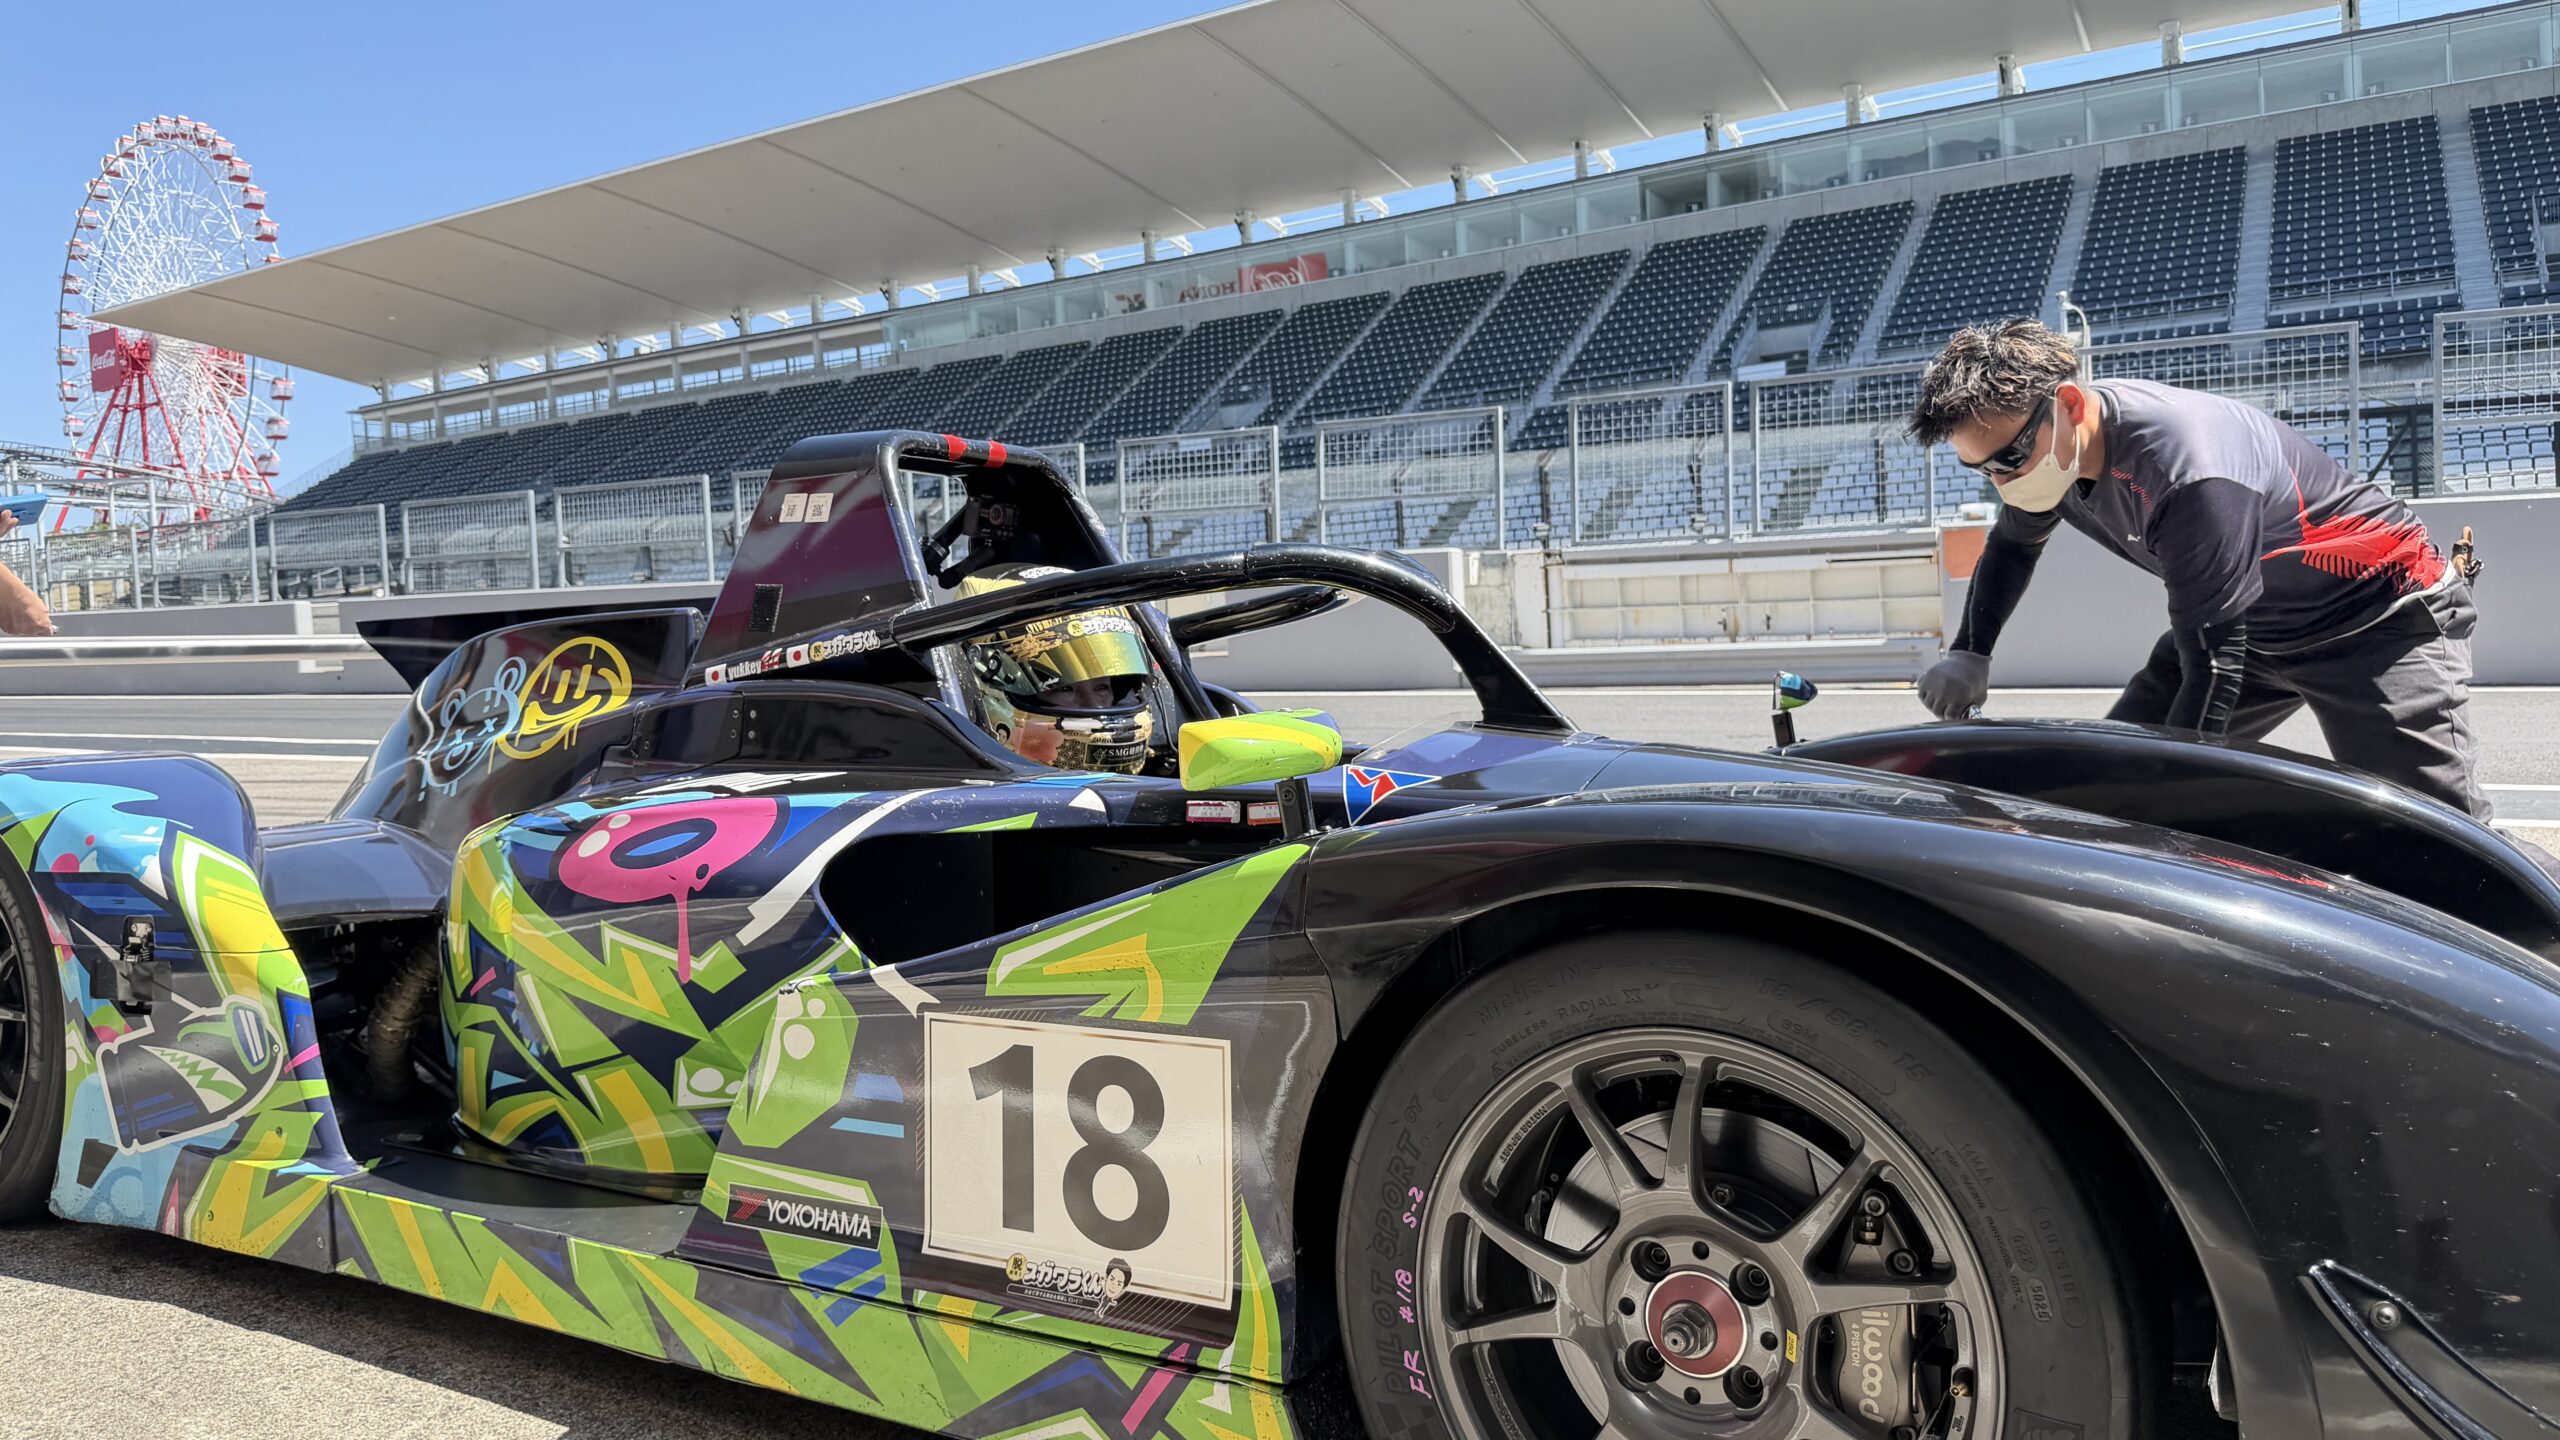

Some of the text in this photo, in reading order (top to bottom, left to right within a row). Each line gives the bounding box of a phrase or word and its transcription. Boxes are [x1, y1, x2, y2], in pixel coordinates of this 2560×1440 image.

[1556, 996, 1618, 1021] RADIAL
[967, 1043, 1170, 1252] 18
[1372, 1126, 1424, 1261] SPORT
[767, 1198, 872, 1240] YOKOHAMA
[2037, 1218, 2079, 1308] OUTSIDE
[1371, 1268, 1403, 1397] PILOT
[1851, 1322, 1861, 1368] 4 PISTON
[1858, 1309, 1890, 1424] ilwood
